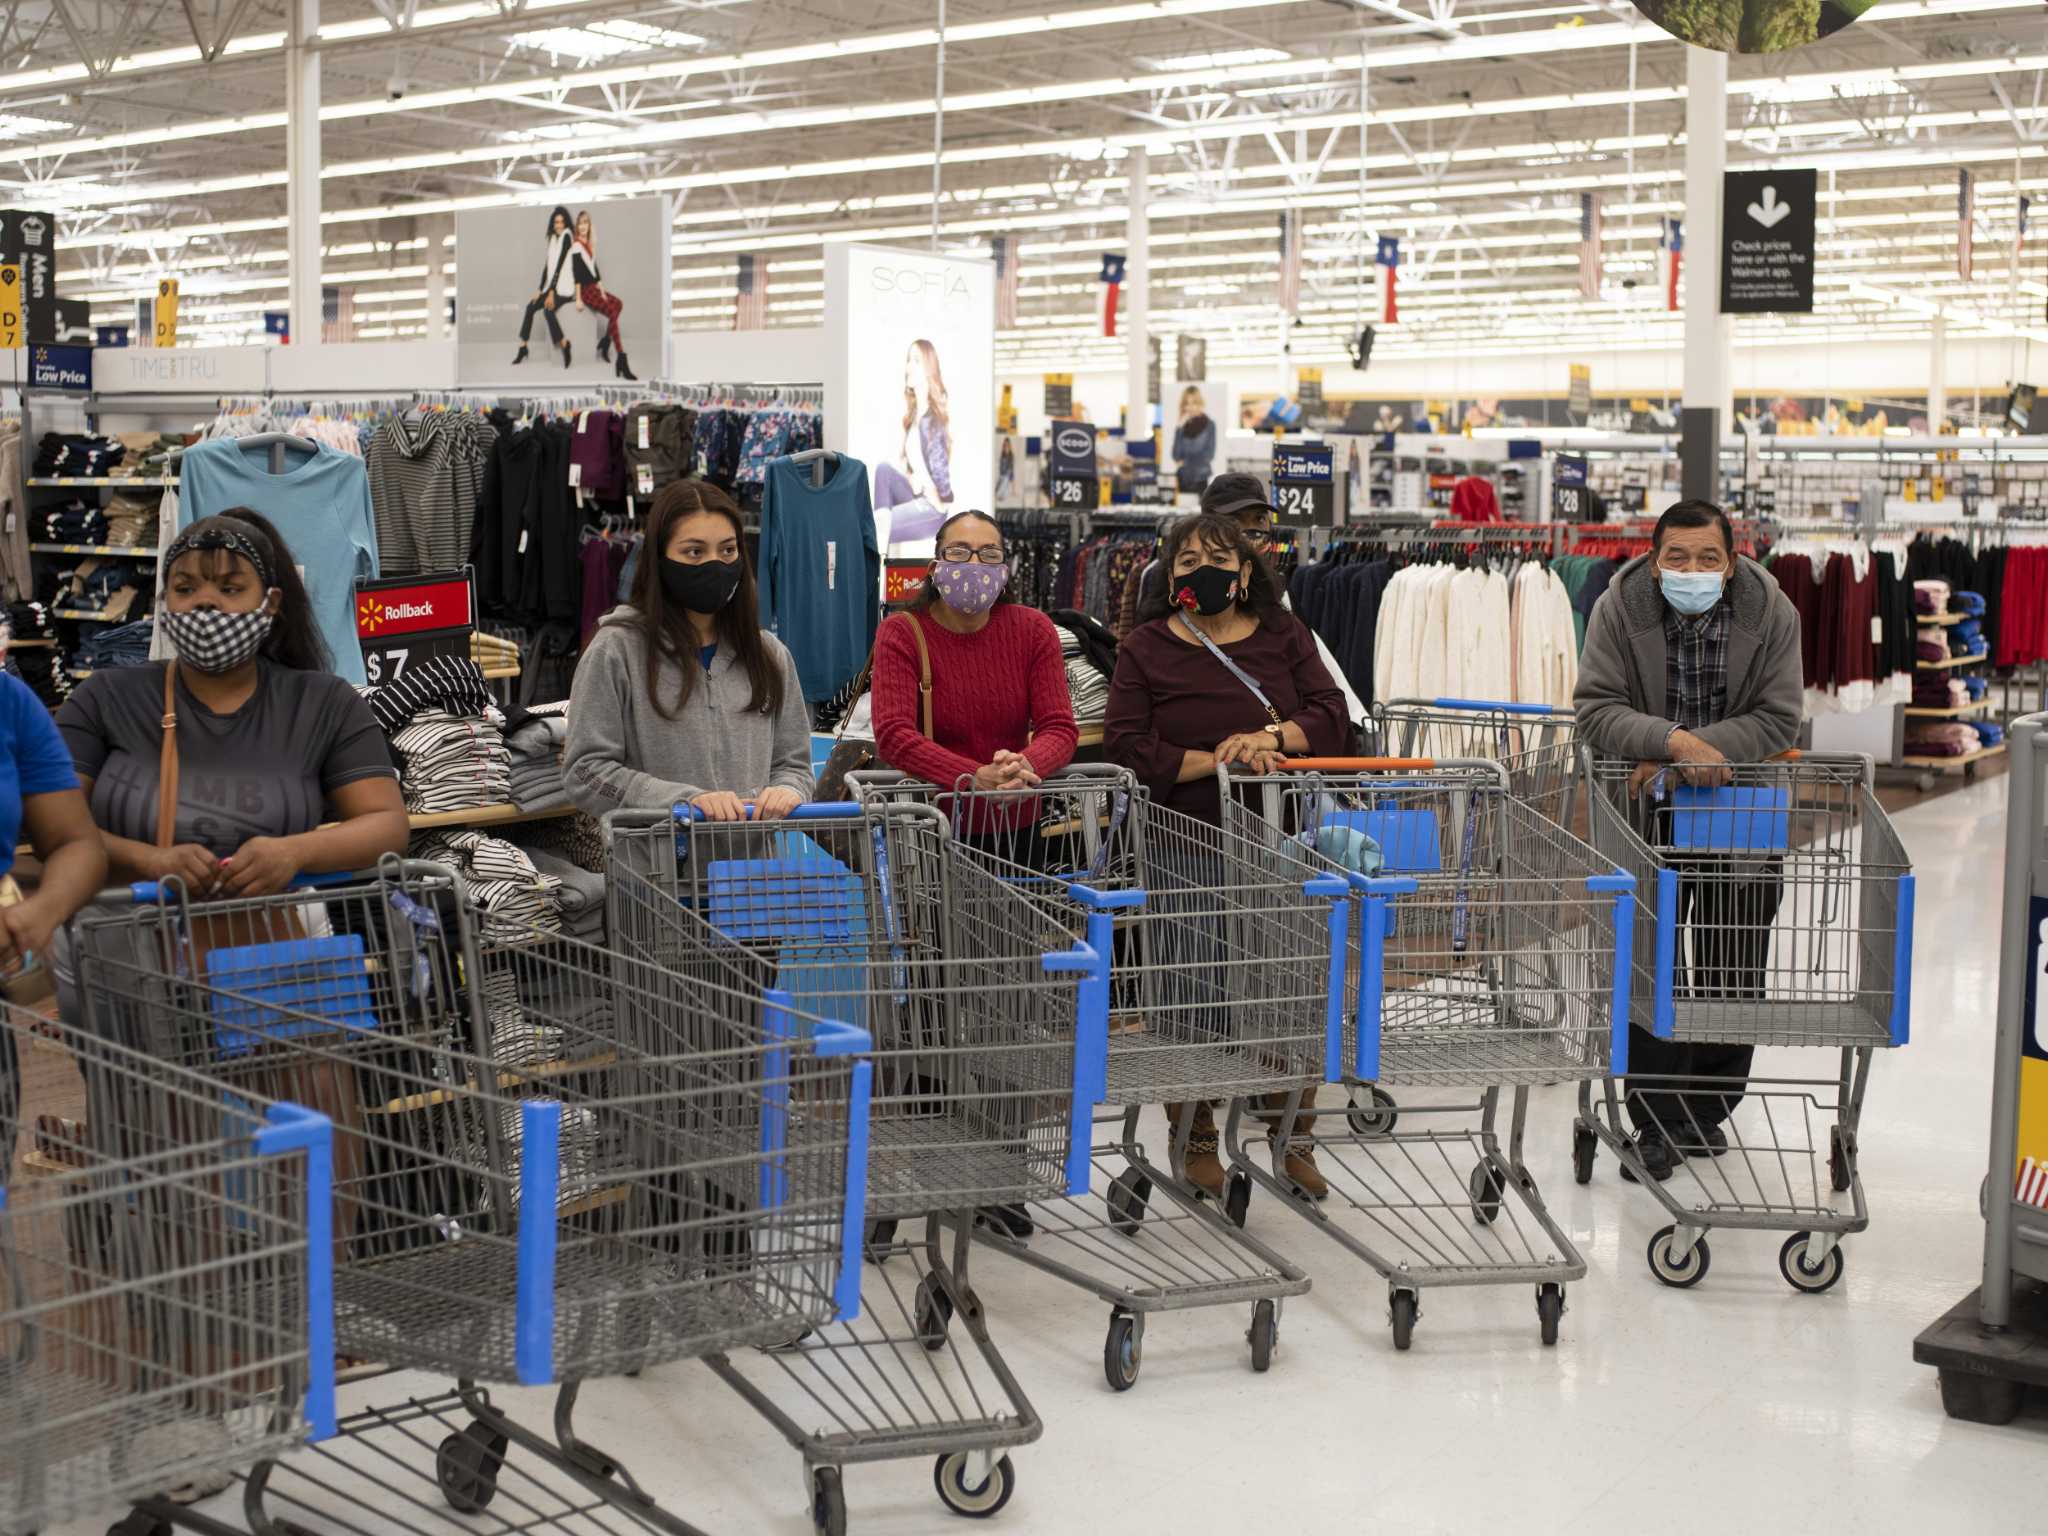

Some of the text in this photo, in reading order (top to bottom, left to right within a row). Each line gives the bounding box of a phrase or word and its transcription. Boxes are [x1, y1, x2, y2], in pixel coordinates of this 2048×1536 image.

[1731, 239, 1791, 253] Check prices
[1731, 252, 1806, 264] here or with the
[31, 252, 48, 299] Men
[1731, 266, 1771, 278] Walmart
[3, 312, 16, 327] D
[7, 332, 15, 346] 7
[36, 369, 86, 384] Low Price
[1287, 461, 1330, 475] Low Price
[1055, 480, 1082, 503] $26
[1279, 487, 1315, 515] $24
[385, 600, 433, 620] Rollback
